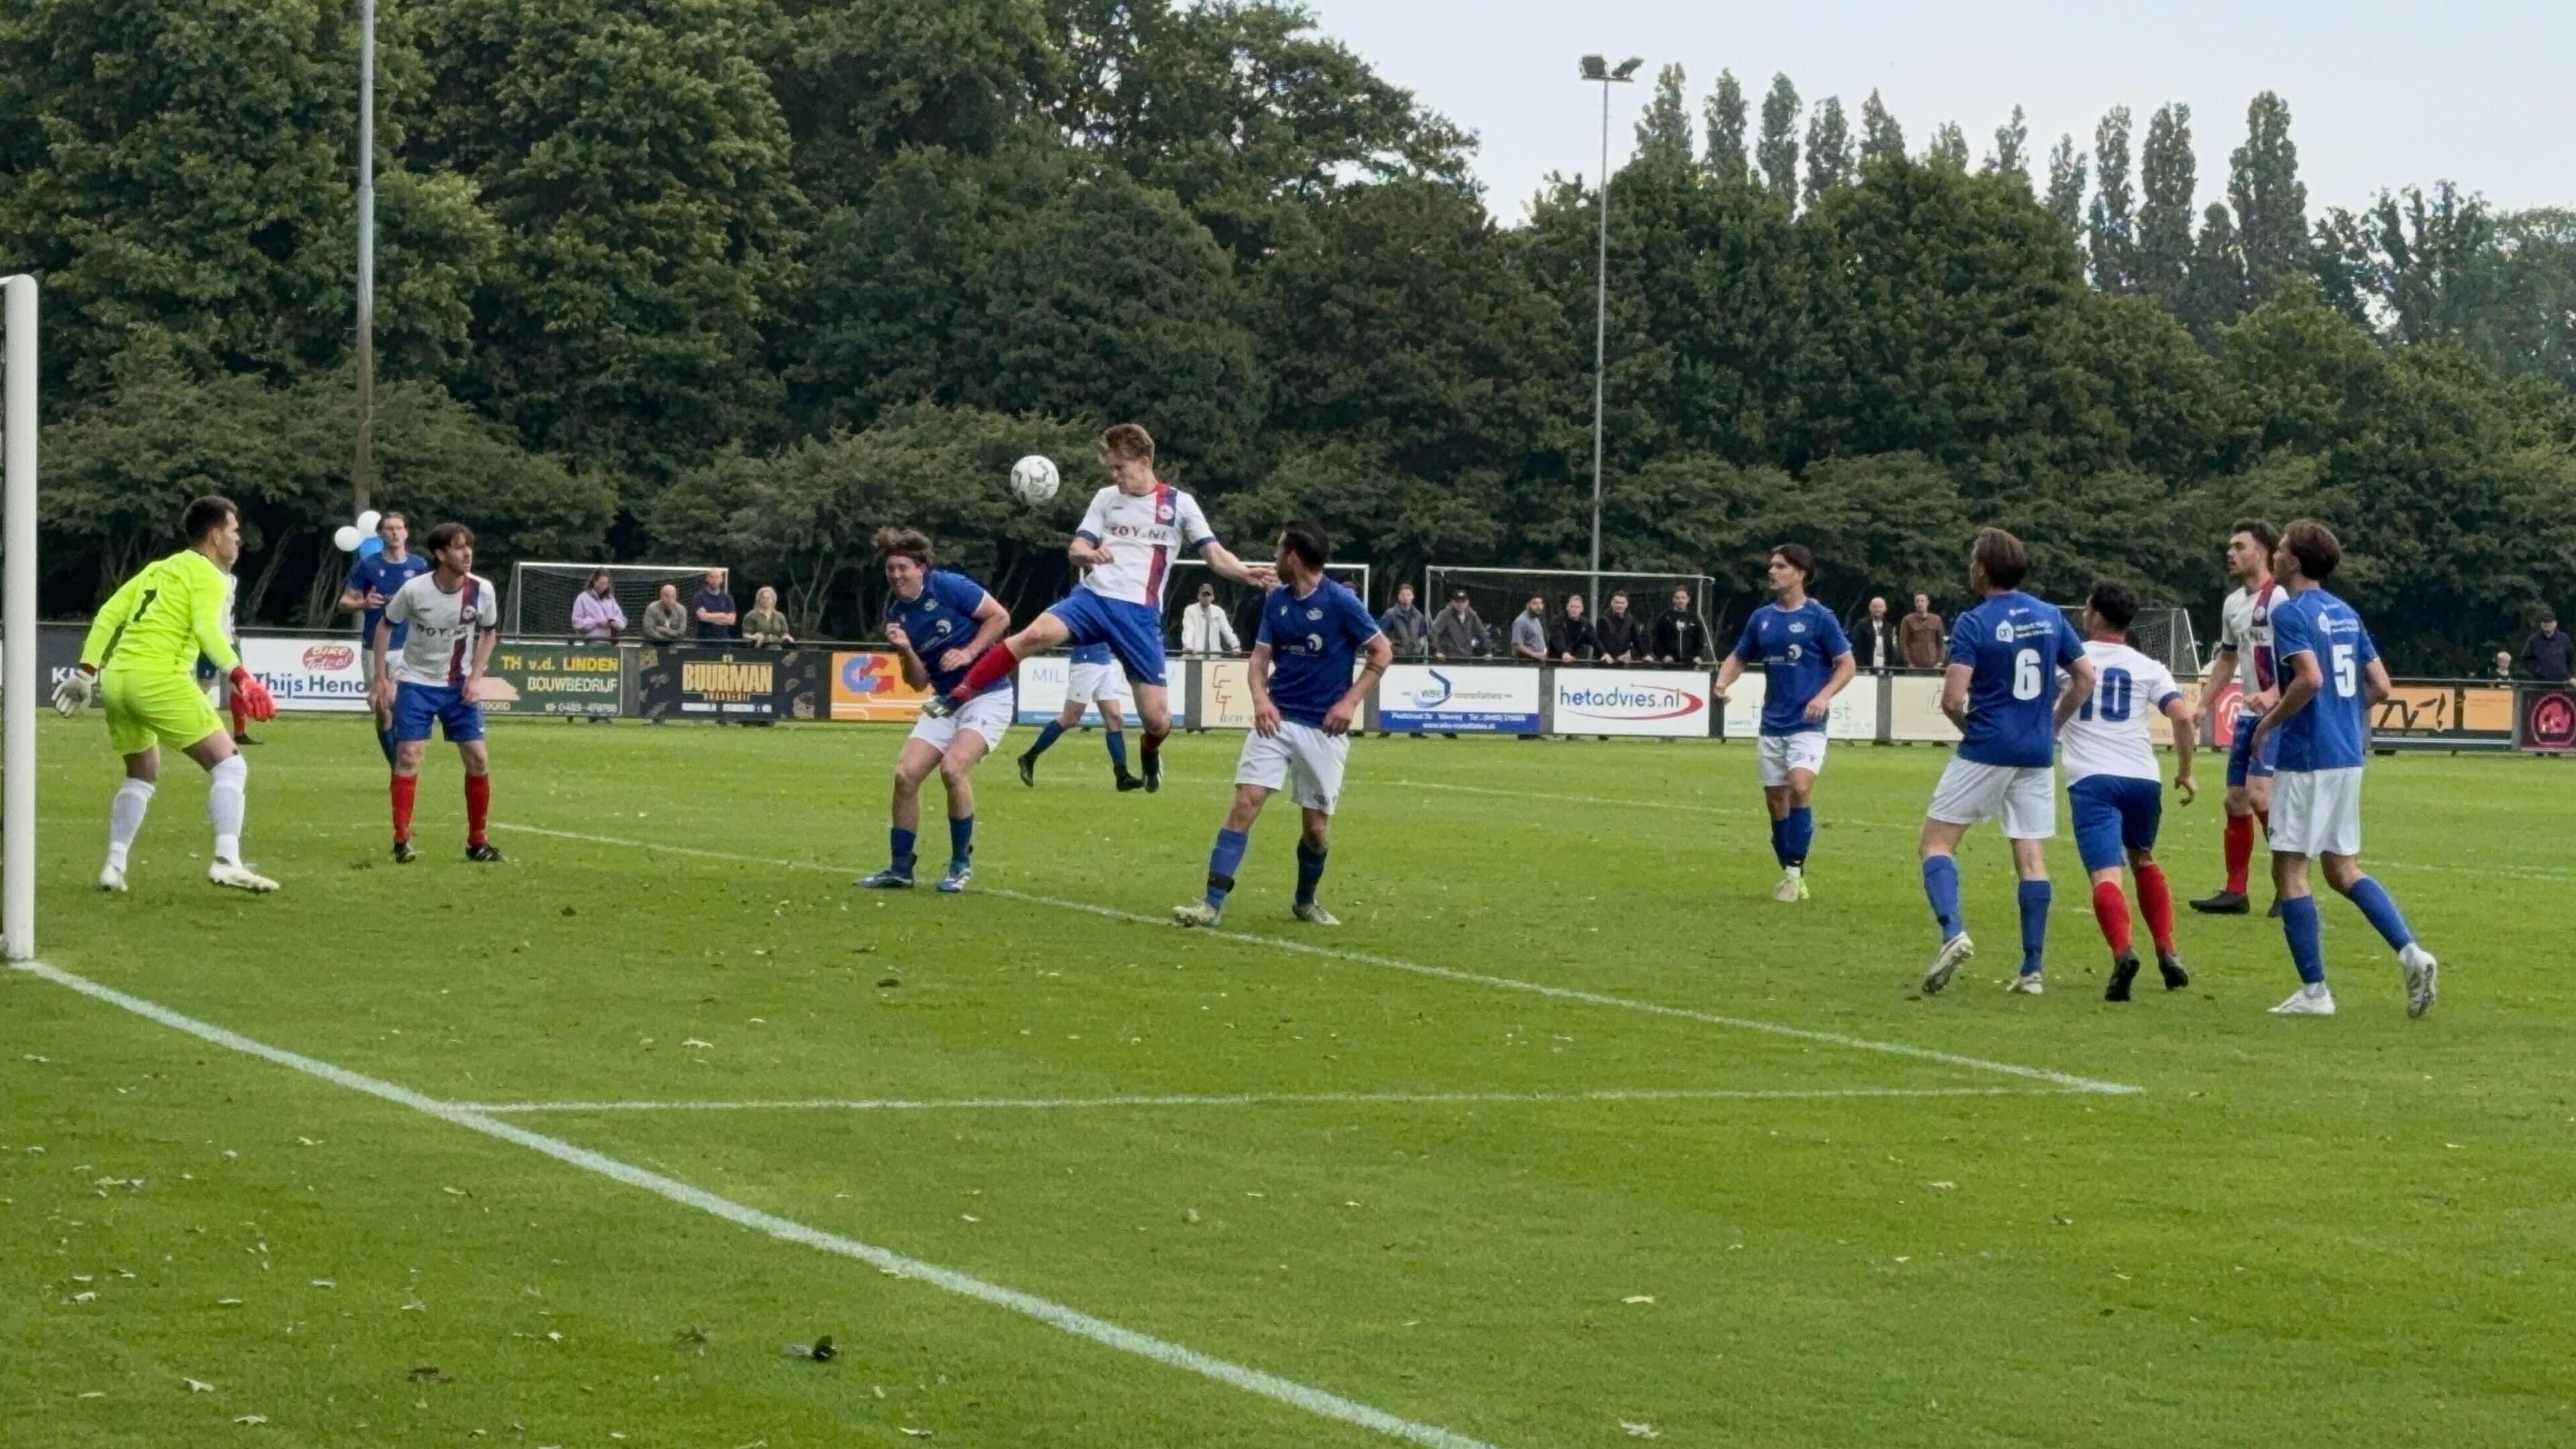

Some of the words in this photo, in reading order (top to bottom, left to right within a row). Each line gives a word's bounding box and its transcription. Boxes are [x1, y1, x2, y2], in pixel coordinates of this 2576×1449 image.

[133, 588, 158, 623] 1
[501, 655, 522, 670] TH
[528, 657, 556, 670] v.d.
[563, 657, 619, 672] LINDEN
[2012, 648, 2041, 700] 6
[2332, 643, 2357, 697] 5
[253, 672, 303, 698] Thijs
[527, 676, 619, 692] BOUWBEDRIJF
[683, 663, 773, 693] BUURMAN
[1560, 684, 1680, 708] hetadvies.nl
